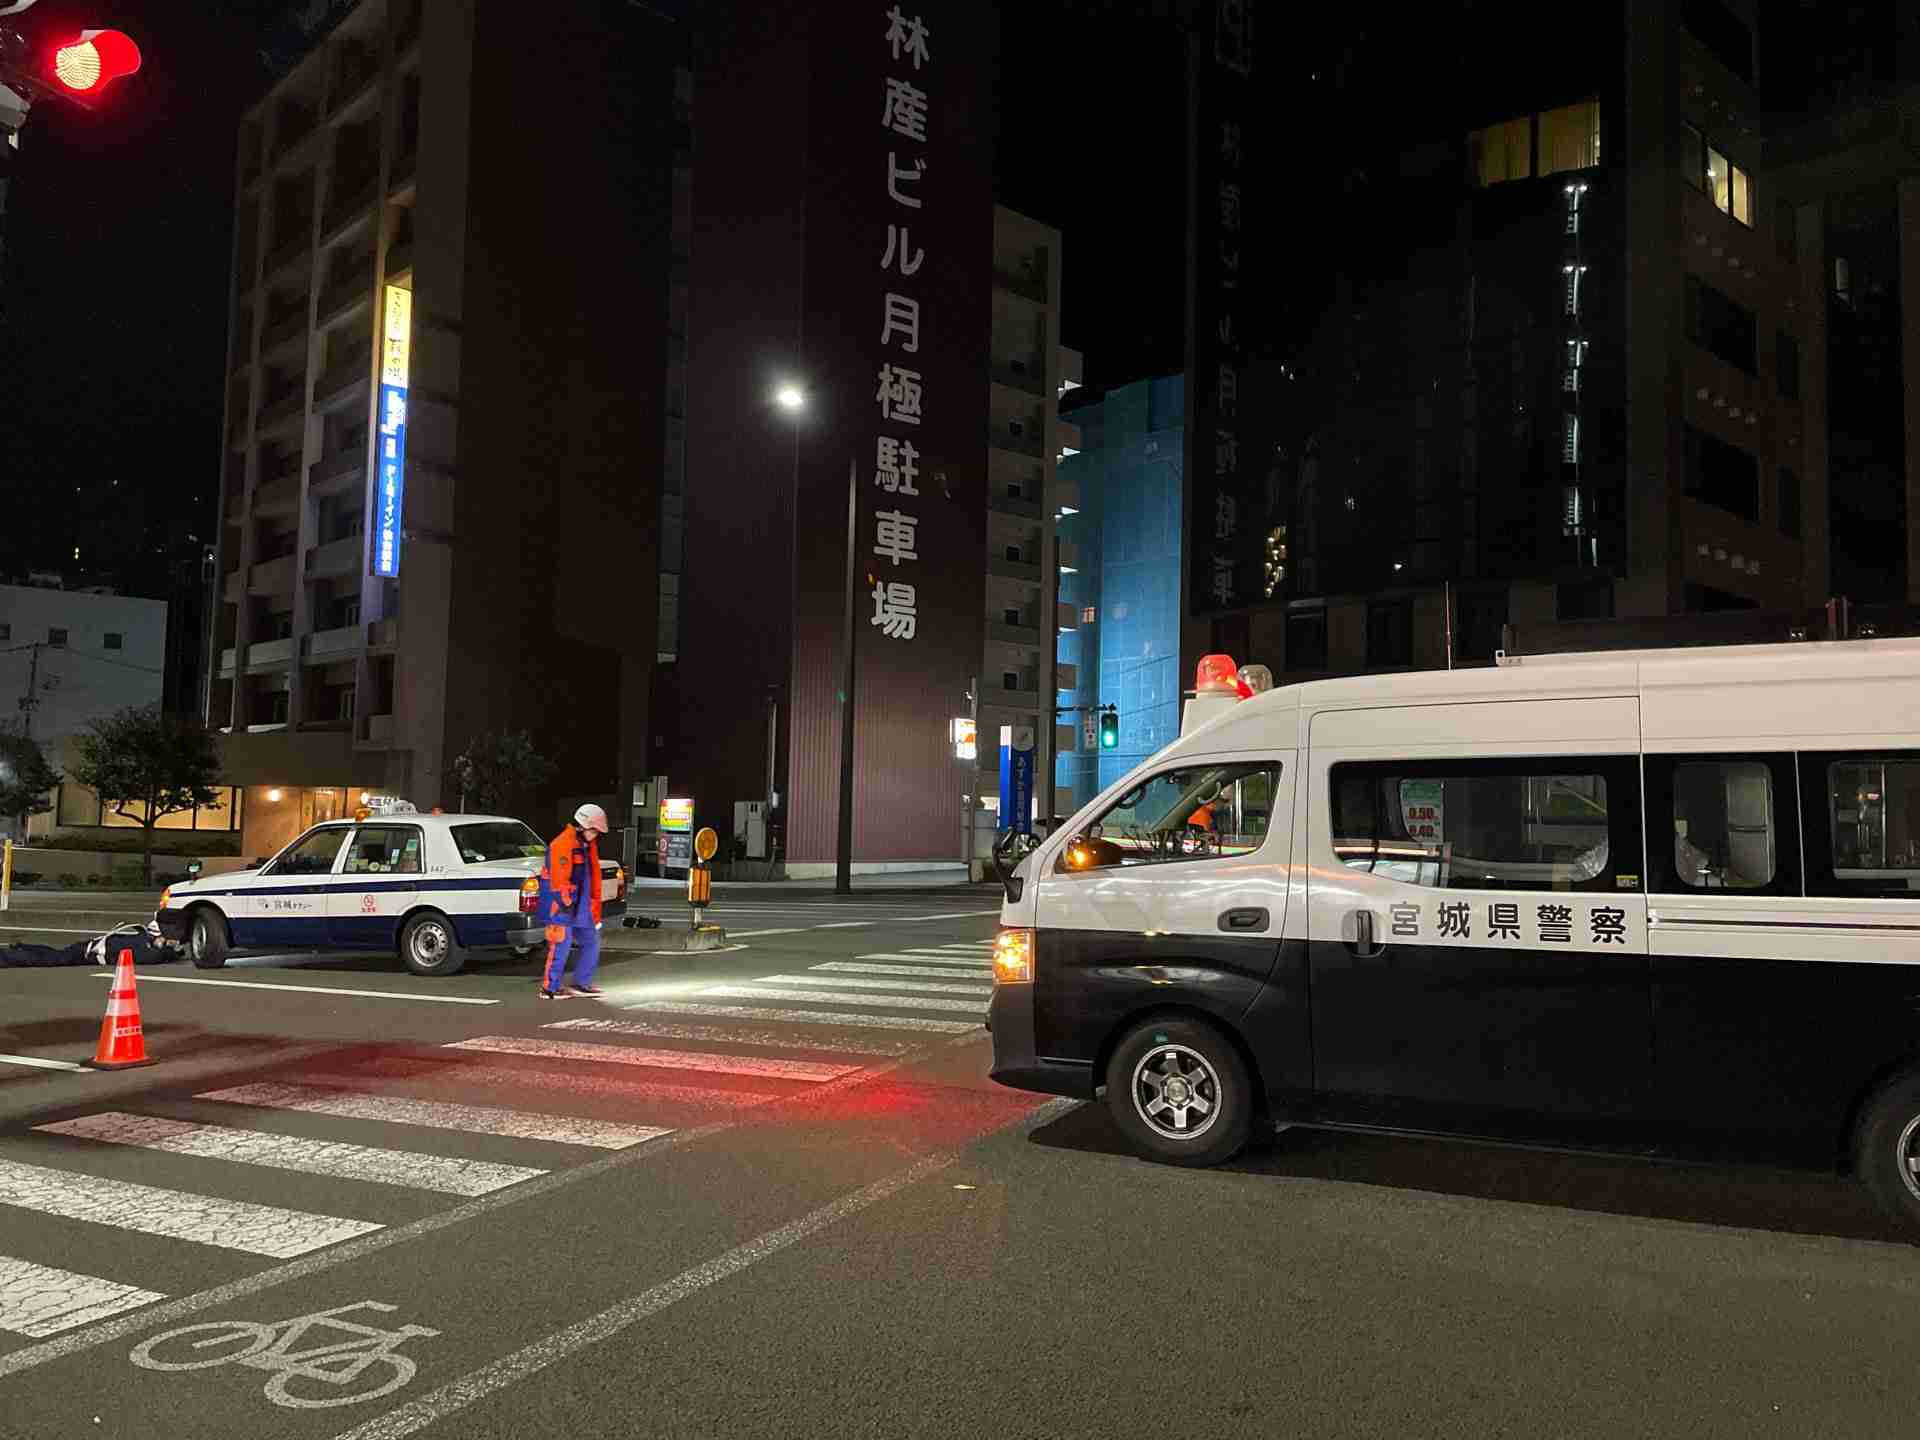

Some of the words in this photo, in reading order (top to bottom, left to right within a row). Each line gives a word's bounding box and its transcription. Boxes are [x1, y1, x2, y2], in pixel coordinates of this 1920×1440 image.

[870, 3, 930, 641] 林産ビル月極駐車場
[1389, 900, 1626, 944] 宮城県警察
